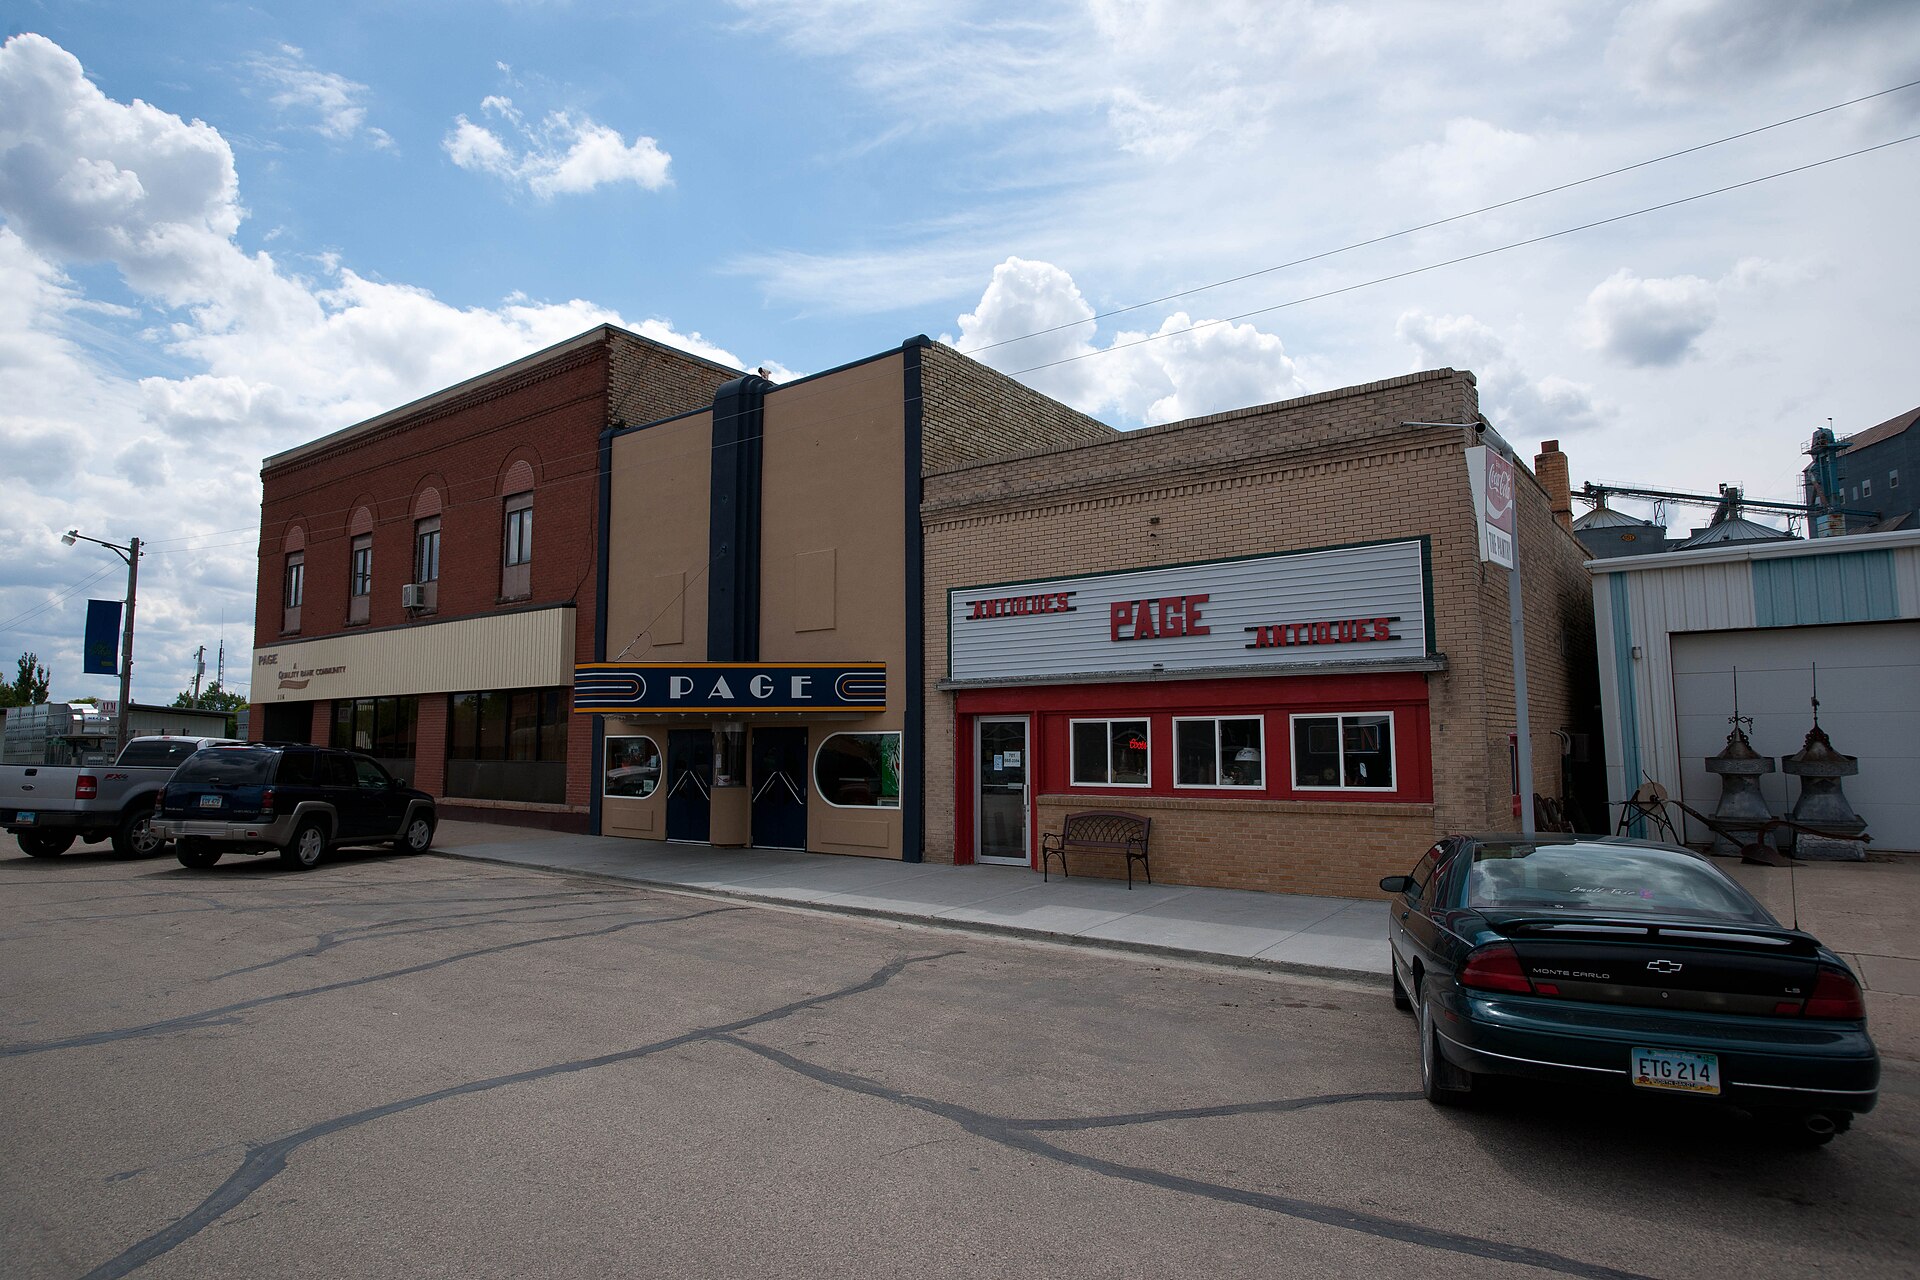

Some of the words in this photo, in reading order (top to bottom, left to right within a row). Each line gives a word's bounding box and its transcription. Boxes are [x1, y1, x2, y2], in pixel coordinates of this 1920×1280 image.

[973, 592, 1069, 619] ANTIQUES
[1111, 594, 1210, 641] PAGE
[1256, 617, 1390, 648] ANTIQUES
[258, 654, 278, 665] PAGE
[669, 674, 812, 699] PAGE
[1533, 968, 1570, 976] MONTE
[1573, 971, 1610, 979] CARLO
[1639, 1058, 1671, 1077] ETG
[1677, 1061, 1711, 1081] 214
